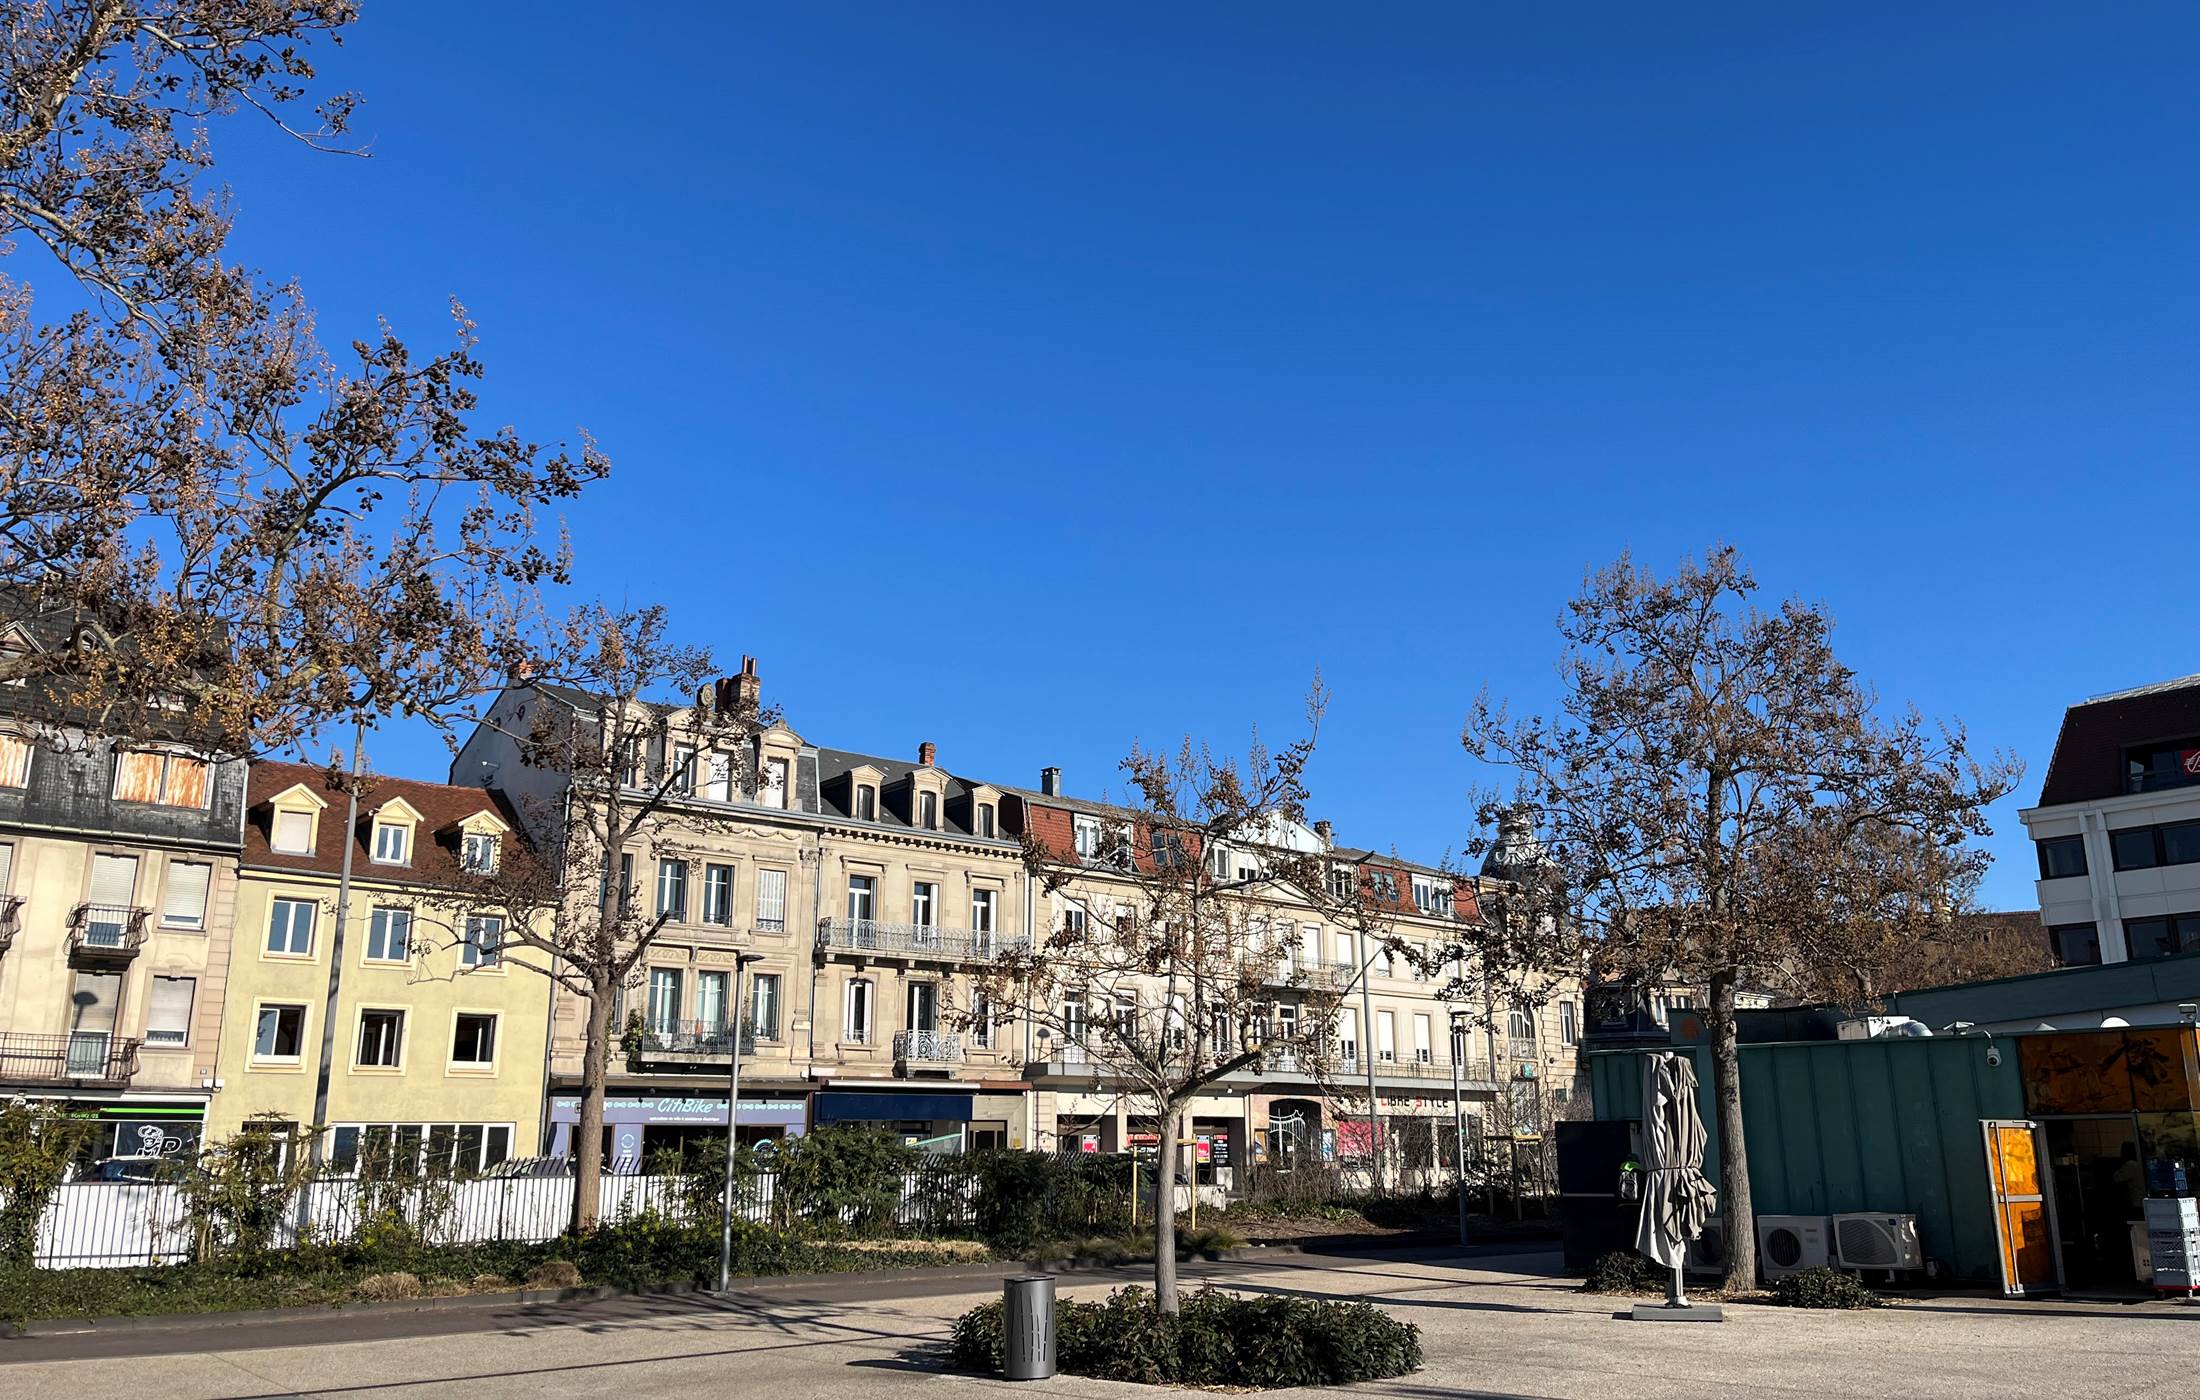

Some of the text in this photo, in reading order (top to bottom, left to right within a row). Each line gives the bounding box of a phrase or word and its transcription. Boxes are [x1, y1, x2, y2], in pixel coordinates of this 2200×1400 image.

[657, 1098, 713, 1113] CitiBike
[1380, 1094, 1449, 1108] LIBRE STYLE
